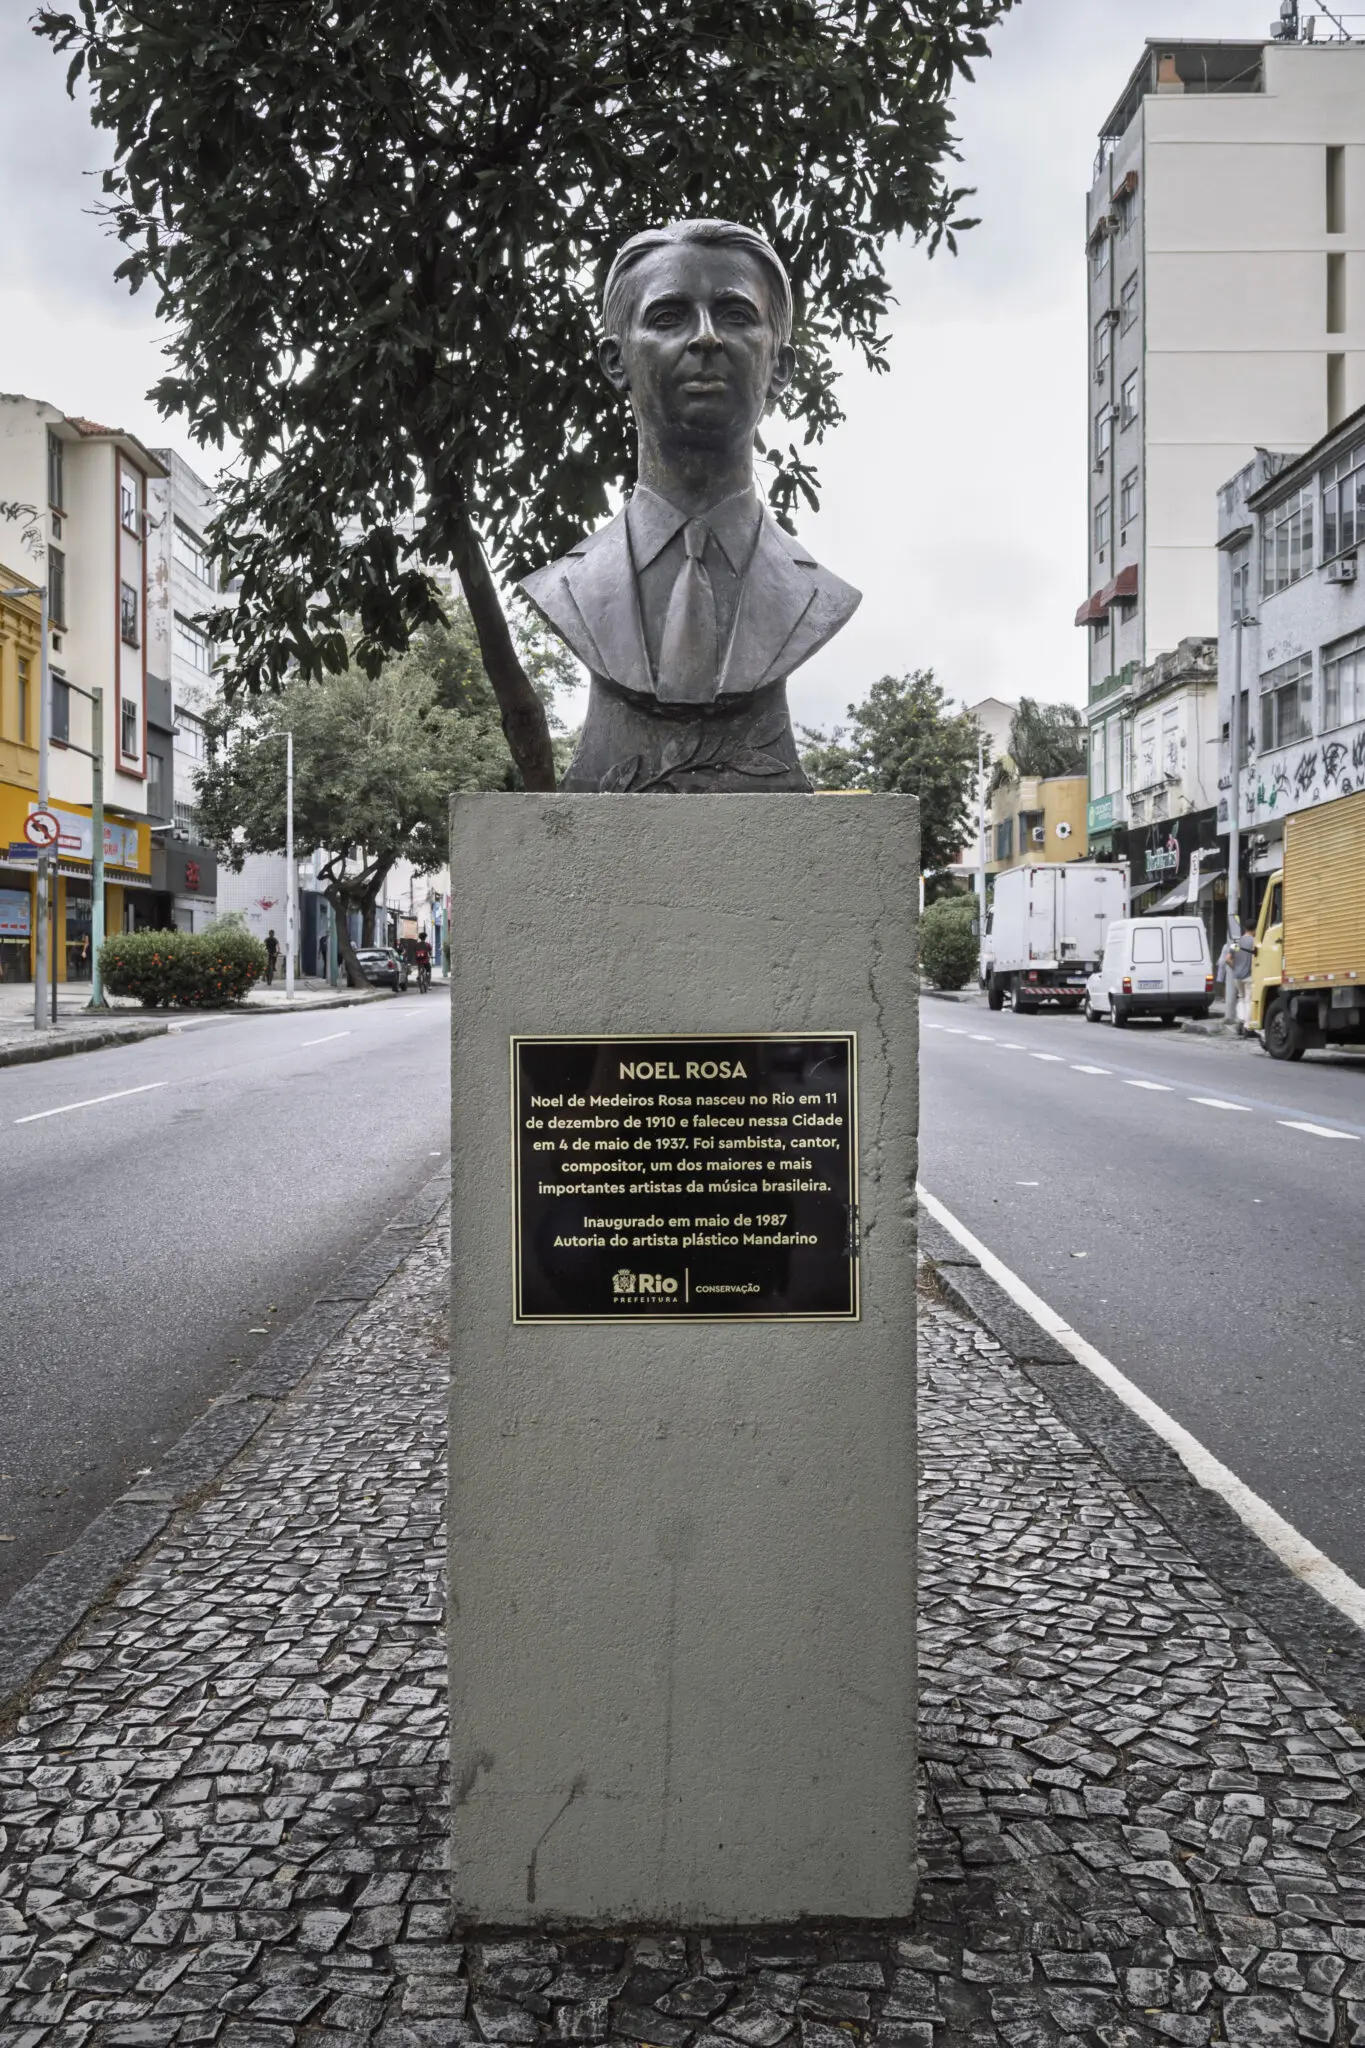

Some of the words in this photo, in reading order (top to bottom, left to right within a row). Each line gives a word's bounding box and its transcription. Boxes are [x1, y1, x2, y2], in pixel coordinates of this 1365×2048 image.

[620, 1062, 680, 1080] NOEL
[686, 1061, 747, 1079] ROSA
[531, 1094, 563, 1107] Noel
[567, 1094, 586, 1107] de
[590, 1093, 654, 1107] Medeiros
[658, 1094, 692, 1106] Rosa
[696, 1096, 745, 1105] nasceu
[750, 1096, 768, 1105] no
[772, 1092, 795, 1105] Rio
[799, 1095, 821, 1104] em
[825, 1092, 837, 1104] 11
[525, 1116, 544, 1129] de
[548, 1115, 620, 1129] dezembro
[623, 1115, 642, 1128] de
[645, 1116, 676, 1128] 1910
[680, 1118, 689, 1127] e
[692, 1114, 744, 1127] faleceu
[749, 1117, 788, 1127] nessa
[792, 1113, 843, 1126] Cidade
[533, 1141, 555, 1151] em
[559, 1139, 568, 1150] 4
[572, 1137, 591, 1150] de
[595, 1137, 629, 1150] maio
[633, 1137, 652, 1150] de
[655, 1138, 689, 1149] 1937.
[693, 1136, 714, 1149] Foi
[718, 1136, 786, 1151] sambista,
[790, 1137, 840, 1150] cantor,
[561, 1159, 646, 1175] compositor,
[650, 1162, 672, 1171] um
[677, 1158, 702, 1171] dos
[707, 1157, 763, 1171] maiores
[767, 1161, 775, 1170] e
[780, 1157, 812, 1170] mais
[538, 1181, 625, 1197] importantes
[629, 1180, 682, 1193] artistas
[686, 1180, 704, 1193] da
[708, 1179, 758, 1192] música
[762, 1178, 831, 1192] brasileira.
[584, 1214, 664, 1230] Inaugurado
[668, 1218, 690, 1227] em
[695, 1214, 730, 1227] maio
[734, 1213, 752, 1226] de
[756, 1214, 788, 1226] 1987
[553, 1234, 605, 1247] Autoria
[609, 1233, 628, 1247] do
[632, 1233, 678, 1246] artista
[683, 1232, 739, 1248] plástico
[743, 1232, 818, 1245] Mandarino
[639, 1273, 678, 1294] Rio
[695, 1282, 760, 1294] CONSERVAÇÃO
[613, 1296, 678, 1304] PREFEITURA
